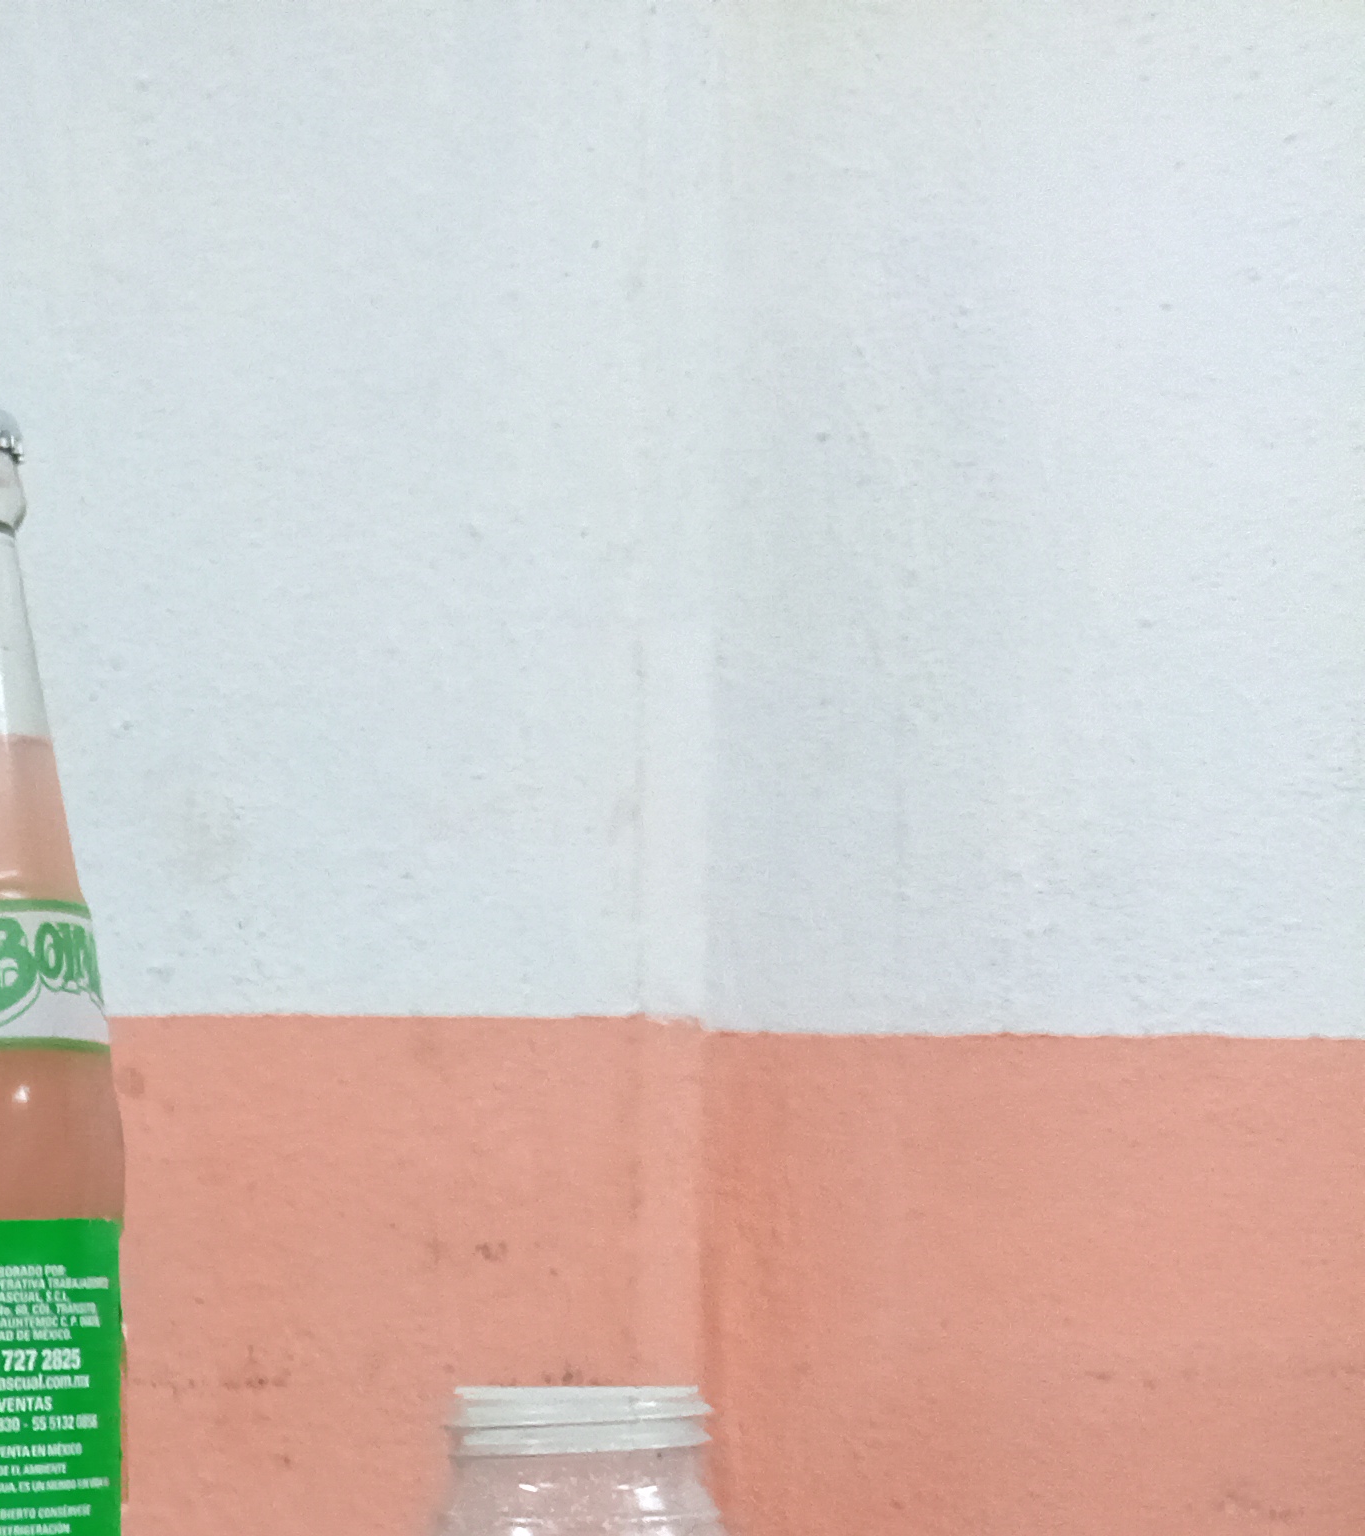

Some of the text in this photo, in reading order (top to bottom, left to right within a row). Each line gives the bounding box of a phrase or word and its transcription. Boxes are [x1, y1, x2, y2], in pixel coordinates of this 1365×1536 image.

[16, 1329, 31, 1342] DE
[1, 1349, 38, 1372] 727
[41, 1348, 81, 1371] 2825
[32, 1415, 47, 1431] 55
[31, 1444, 47, 1457] EN
